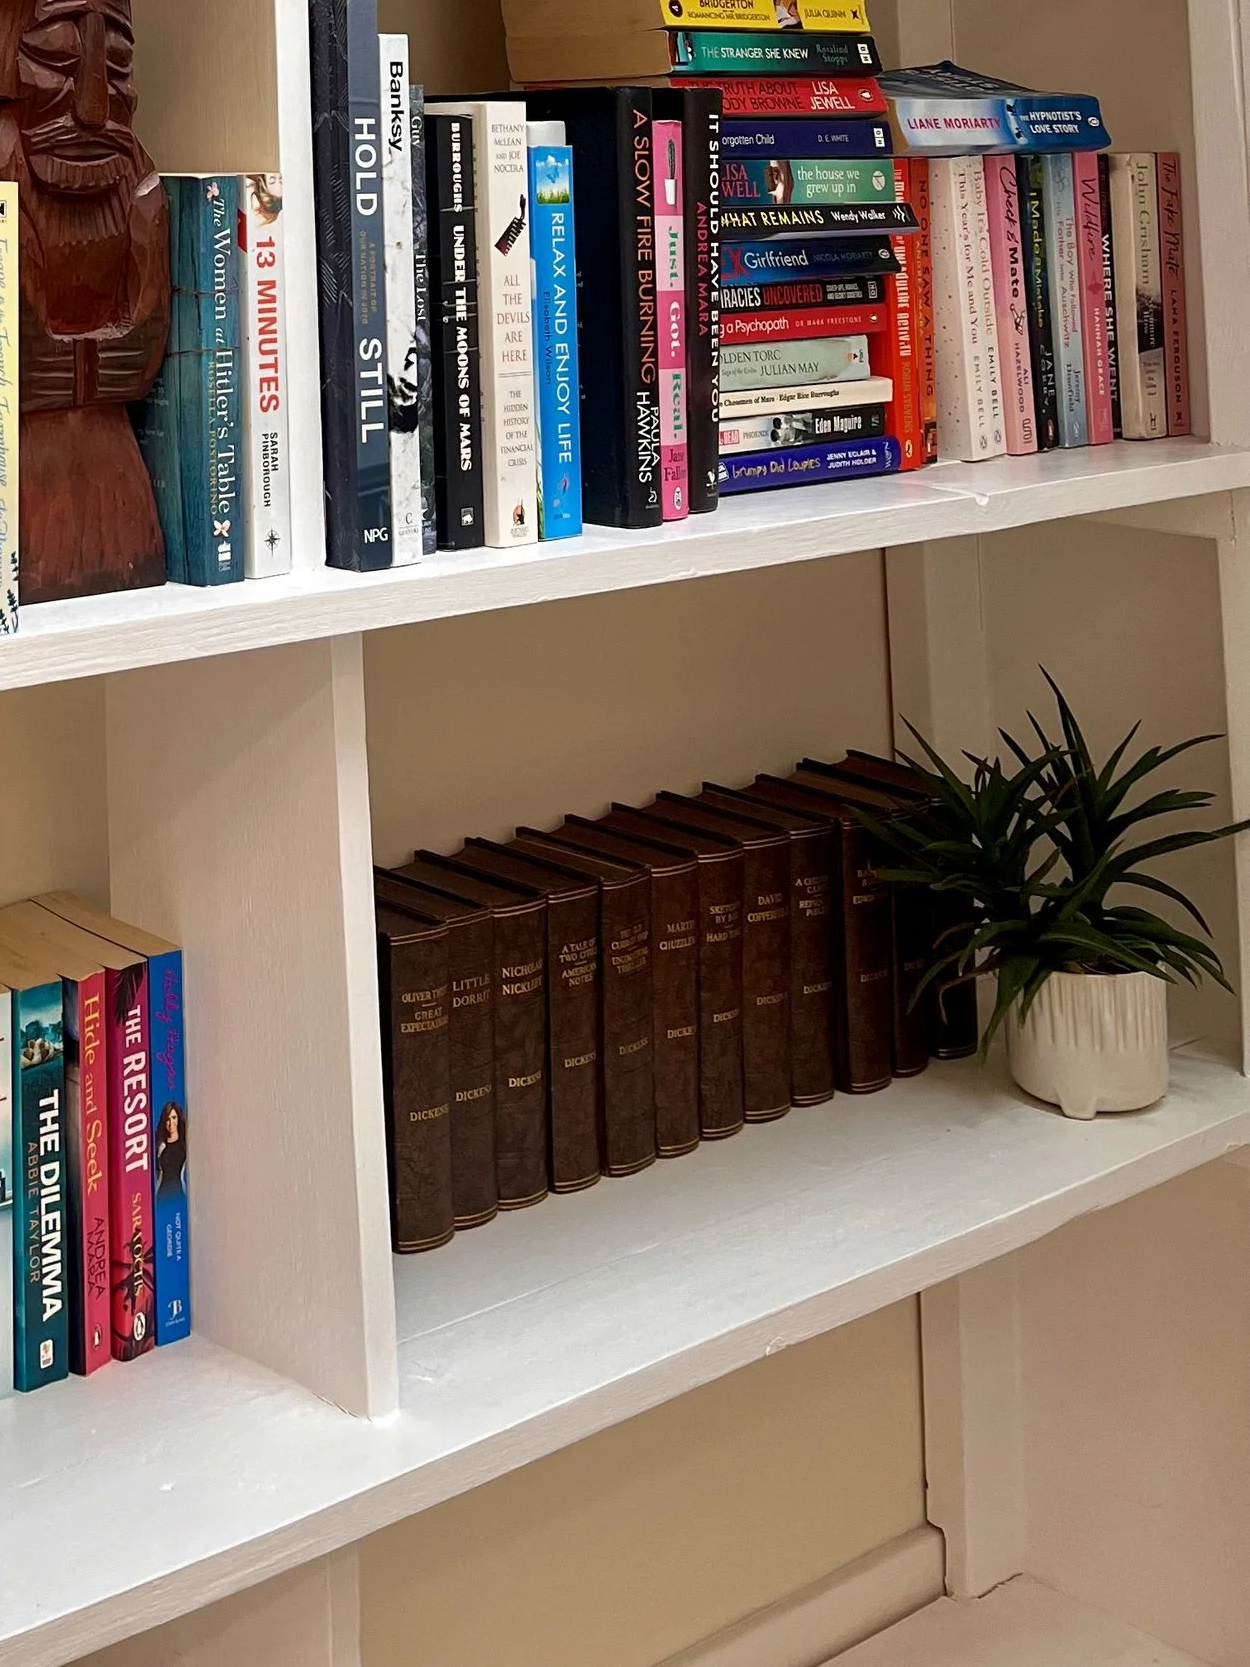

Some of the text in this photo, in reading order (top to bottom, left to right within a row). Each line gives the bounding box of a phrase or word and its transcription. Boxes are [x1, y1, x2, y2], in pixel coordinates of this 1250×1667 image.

[387, 61, 404, 153] Banksy
[810, 95, 856, 111] JEWELL
[811, 81, 839, 96] LISA
[907, 115, 1002, 130] LIANE MORIARTY
[353, 117, 384, 446] HOLD STILL
[744, 251, 809, 270] Girlfriend
[254, 235, 281, 415] 13 MINUTES
[551, 212, 572, 464] RELAX AND ENJOY LIFE
[636, 390, 653, 484] HAWKINS
[650, 406, 661, 468] PAULA
[452, 973, 491, 992] LITTLE
[452, 989, 491, 1009] DORRIT
[124, 1005, 148, 1173] THE RESORT
[410, 1104, 449, 1122] DICKENS
[38, 1088, 63, 1322] THE DILEMMA
